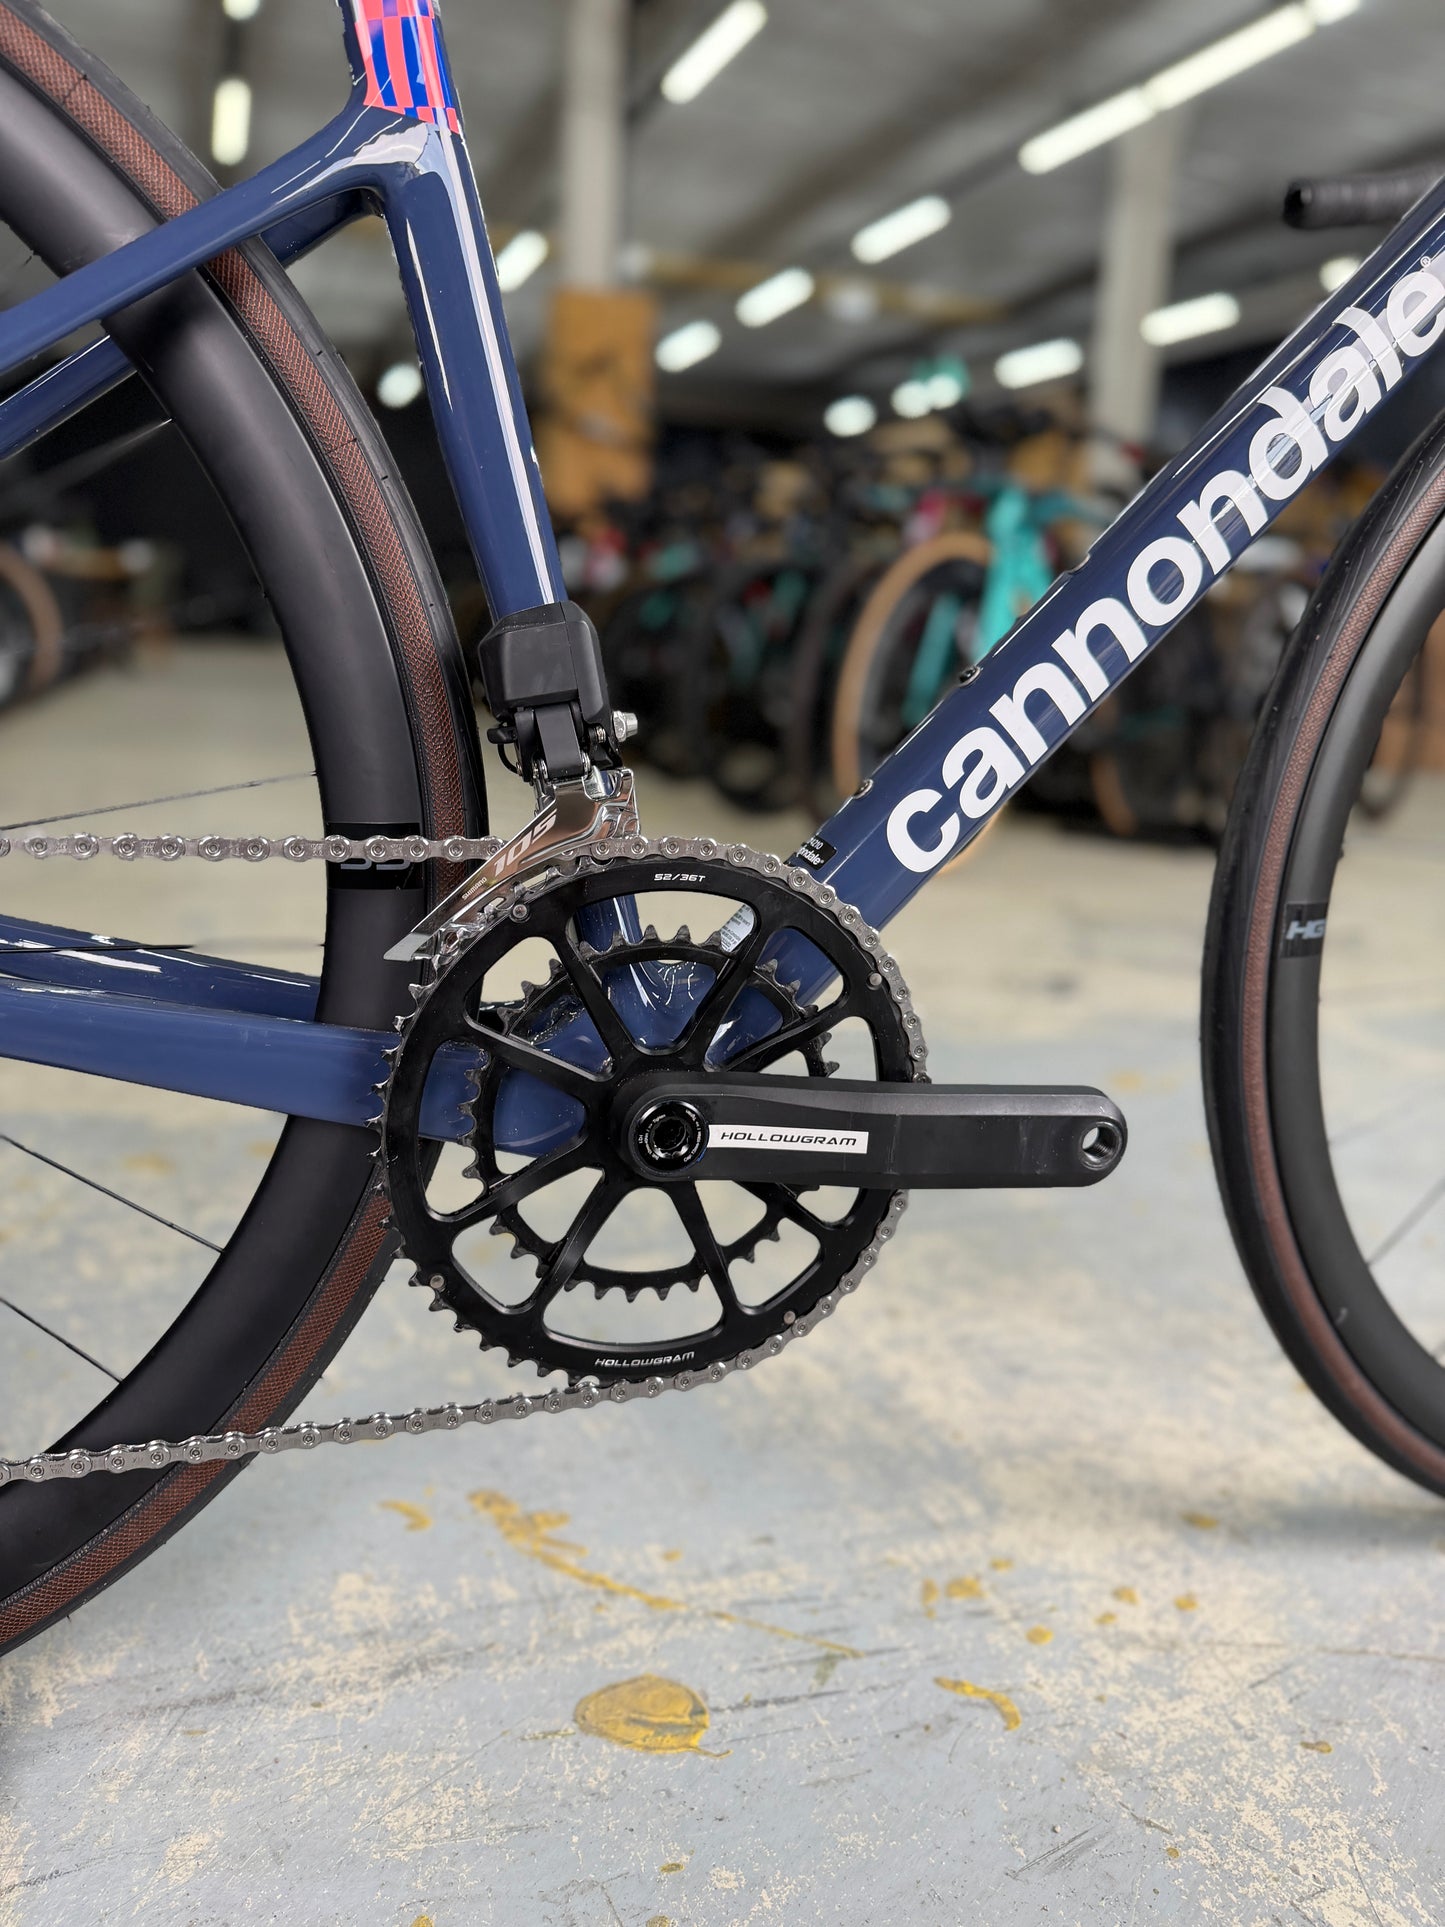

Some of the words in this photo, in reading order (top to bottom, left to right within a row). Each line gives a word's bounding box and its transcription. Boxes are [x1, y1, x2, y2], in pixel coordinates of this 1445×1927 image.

[886, 270, 1445, 874] cannondale
[494, 808, 557, 877] 105
[653, 873, 707, 882] 52/36T
[461, 877, 488, 900] SHIMANO
[720, 1132, 857, 1147] HOLLOWGRAM
[594, 1351, 695, 1367] HOLLOWGRAM
